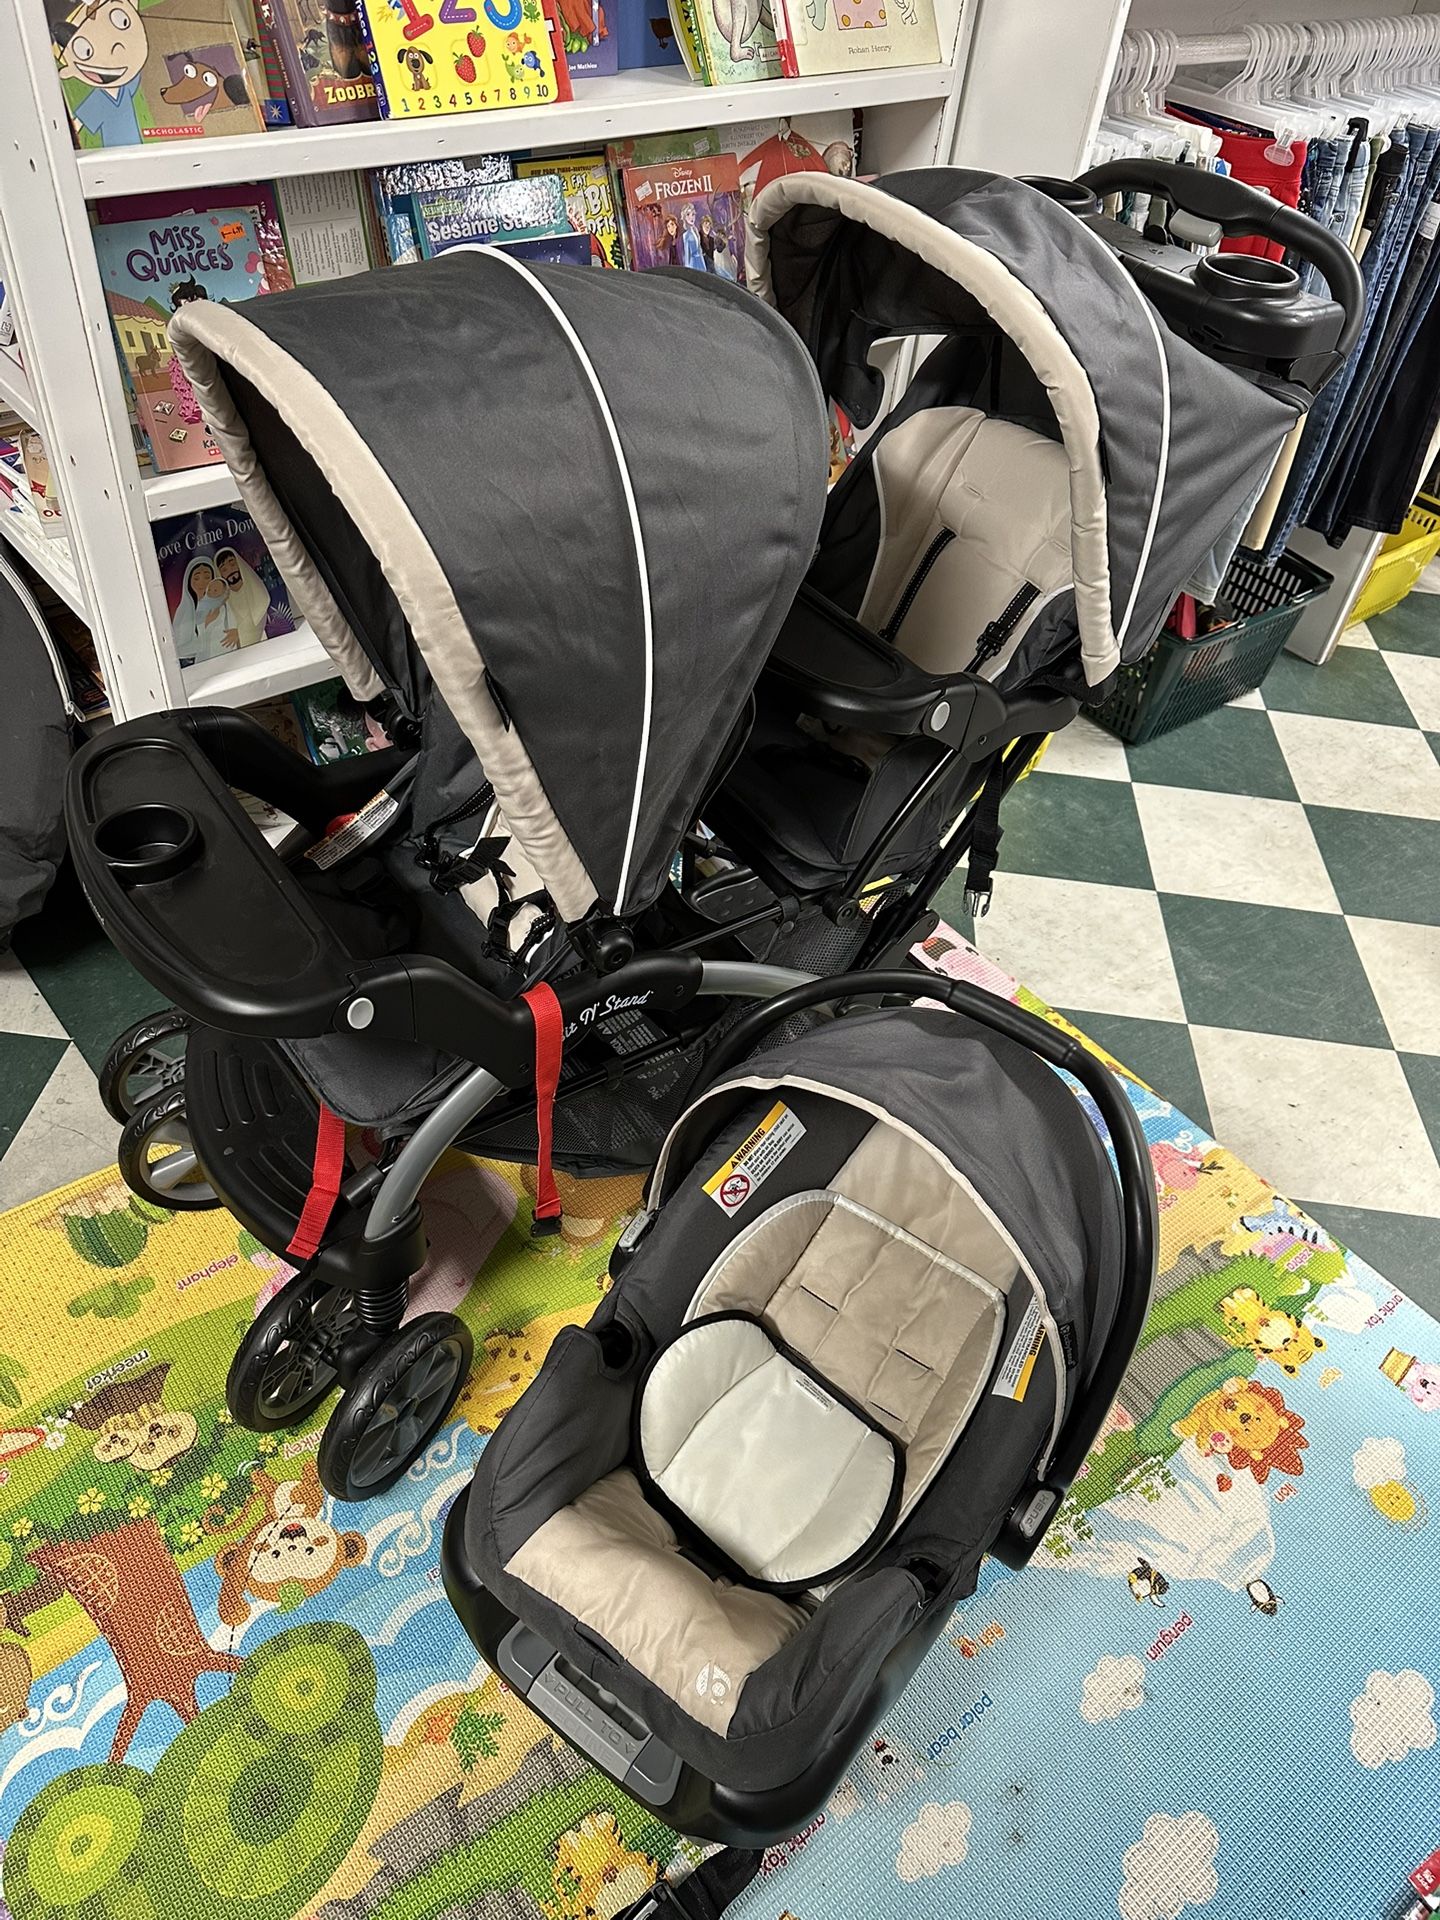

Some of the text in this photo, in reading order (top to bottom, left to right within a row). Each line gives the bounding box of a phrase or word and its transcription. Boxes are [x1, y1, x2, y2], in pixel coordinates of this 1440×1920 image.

[848, 44, 893, 55] Rohan Henry
[324, 83, 377, 105] ZOOBR
[401, 84, 549, 112] 1 2 3 4 5 6 7 8 9 10
[151, 126, 203, 135] SCHOLASTIC
[570, 172, 588, 189] FAT
[671, 167, 693, 178] Disney
[655, 175, 713, 200] FROZEN II
[427, 217, 499, 242] Sesame
[203, 439, 217, 450] KA
[185, 528, 224, 551] Came
[226, 518, 255, 538] Dow
[599, 990, 652, 1018] Stand
[735, 1127, 765, 1162] WARNING
[1158, 1194, 1178, 1213] octo
[623, 1216, 646, 1248] PUSH
[177, 1253, 239, 1291] elephant
[1286, 1248, 1313, 1271] zebra
[1365, 1294, 1403, 1328] arctic fox
[1029, 1320, 1047, 1357] ARNING
[86, 1349, 149, 1390] meerkat
[1275, 1482, 1297, 1502] lion
[1024, 1494, 1049, 1527] PUSH
[1147, 1612, 1193, 1661] penguin
[554, 1683, 624, 1746] PULL TO
[927, 1694, 993, 1761] polar bear
